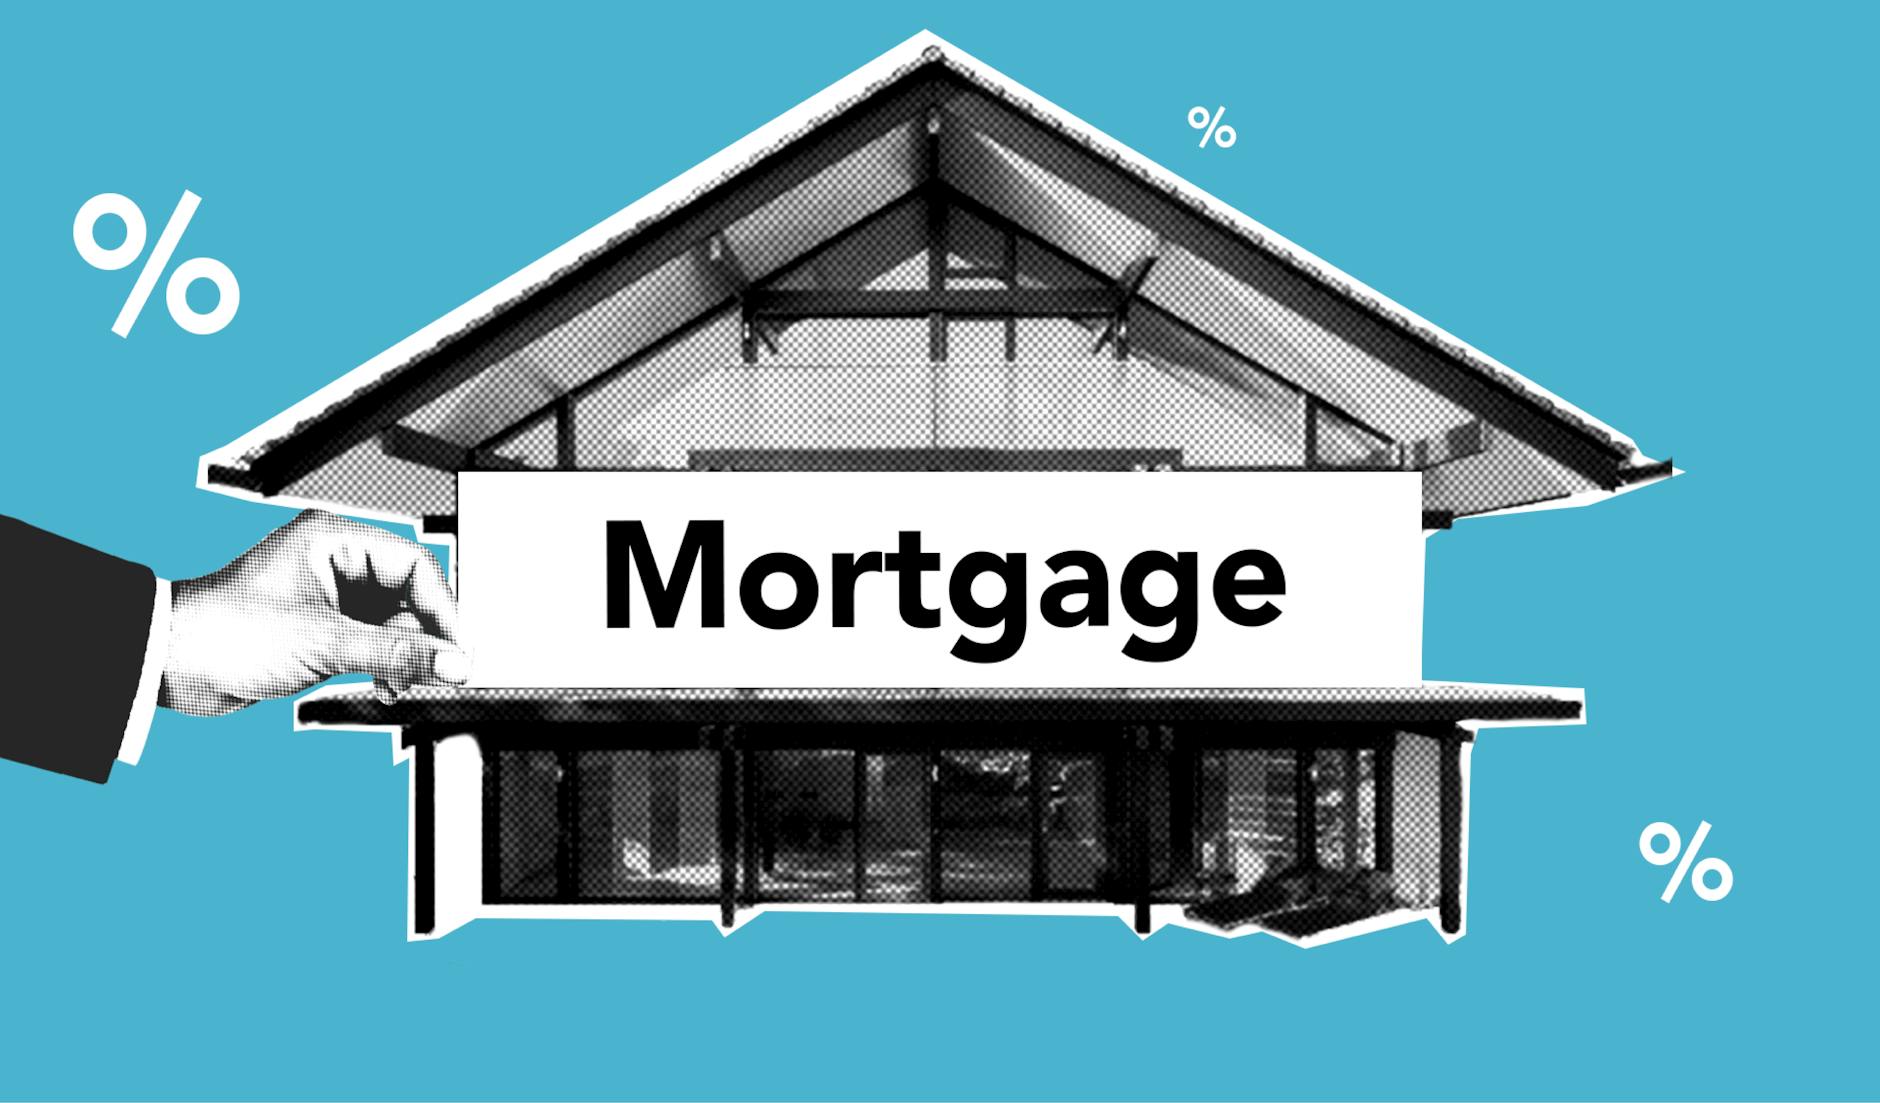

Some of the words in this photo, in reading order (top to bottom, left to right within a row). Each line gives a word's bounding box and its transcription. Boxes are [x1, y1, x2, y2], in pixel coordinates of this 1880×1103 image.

[1187, 105, 1237, 148] %
[73, 189, 240, 339] %
[605, 519, 1287, 664] Mortgage
[1639, 820, 1734, 904] %
